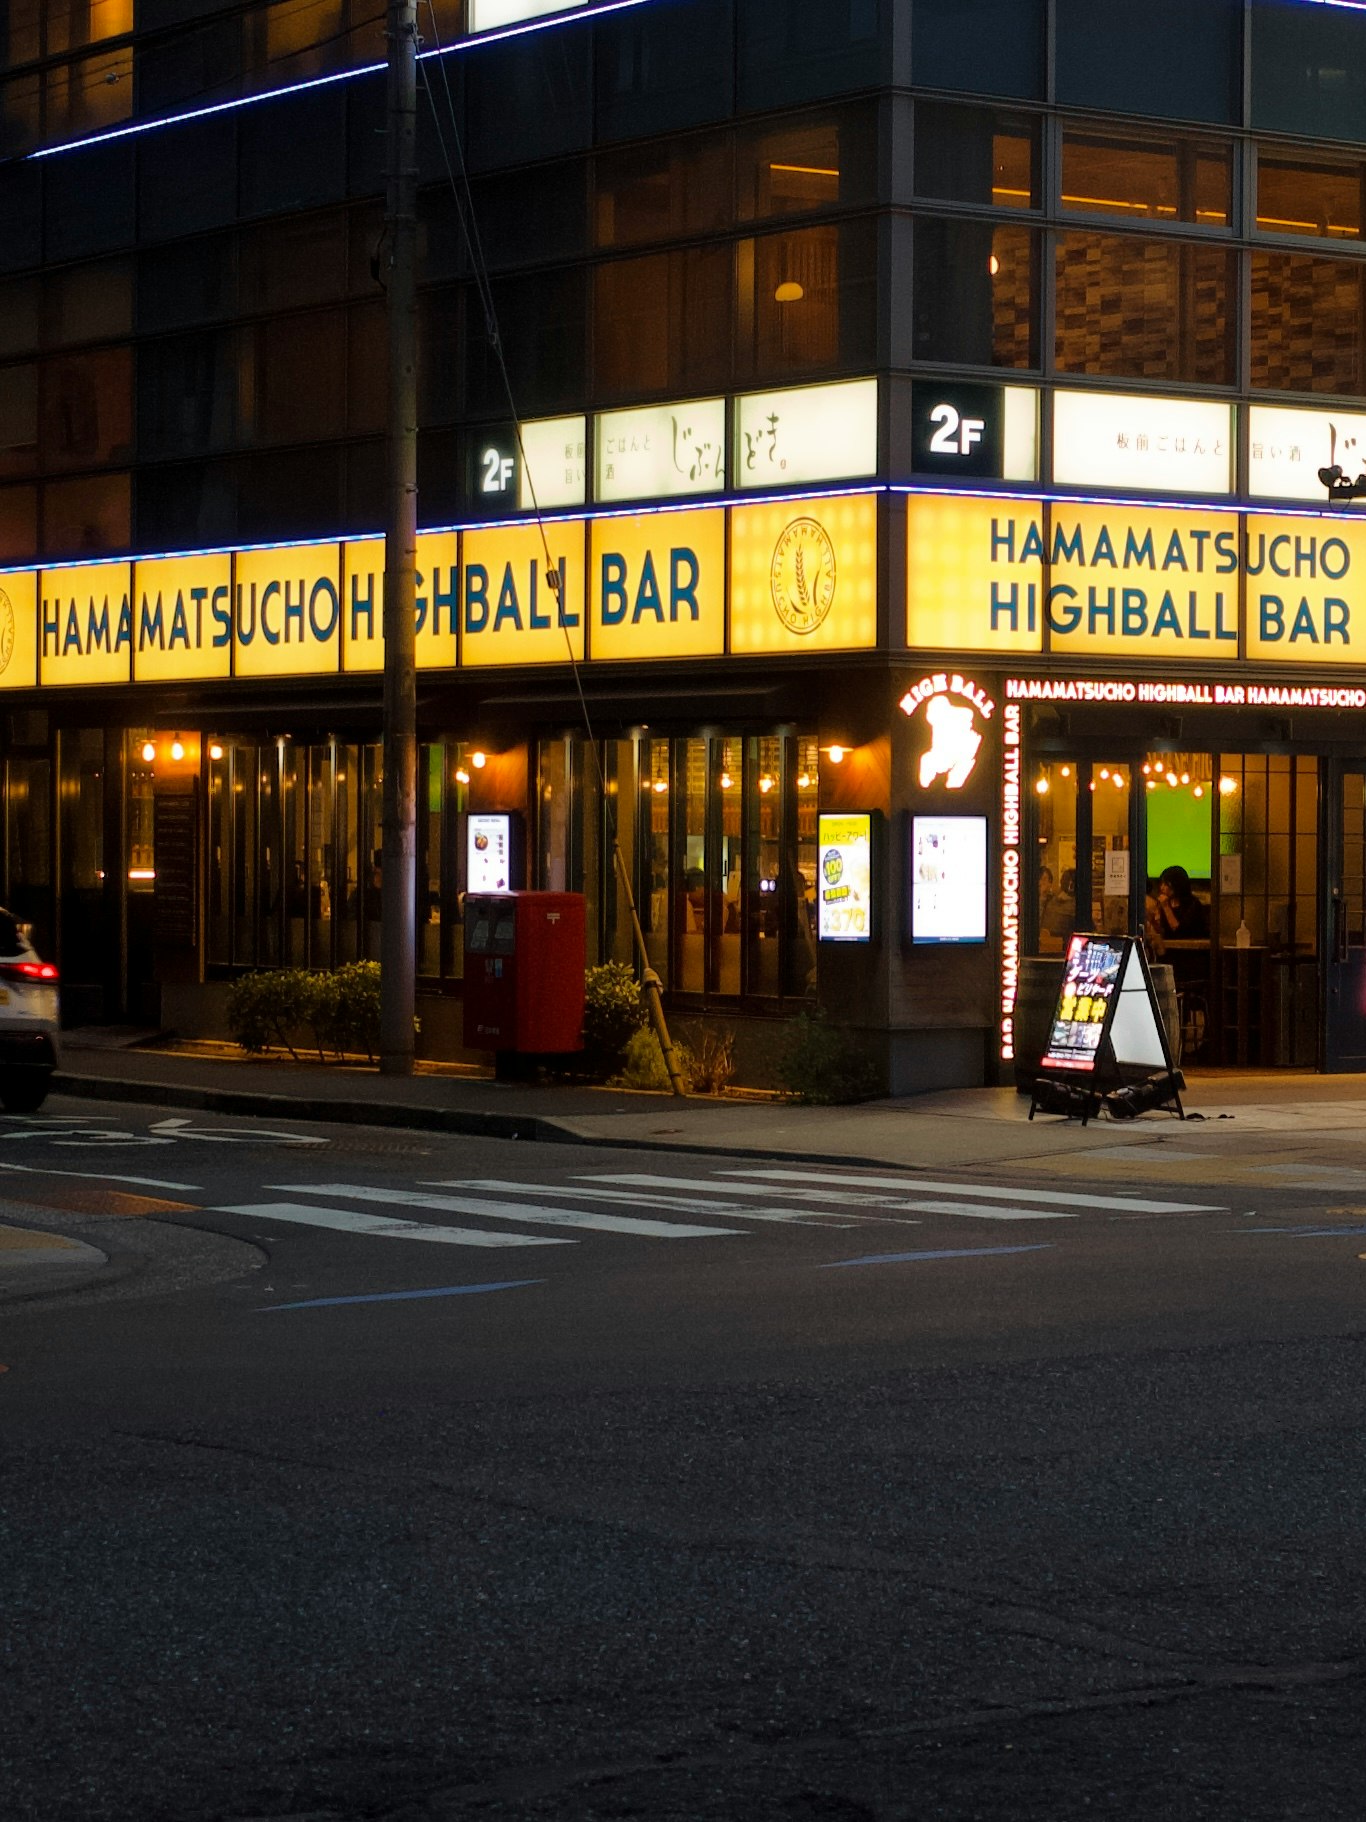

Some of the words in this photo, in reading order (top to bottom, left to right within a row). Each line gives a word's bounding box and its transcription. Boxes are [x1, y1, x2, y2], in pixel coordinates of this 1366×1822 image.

[928, 403, 986, 456] 2F
[482, 447, 514, 493] 2F
[990, 518, 1350, 580] HAMAMATSUCHO
[42, 576, 338, 657] HAMAMATSUCHO
[351, 556, 580, 640] HHBALL
[601, 547, 700, 626] BAR
[990, 581, 1238, 641] HIGHBALL
[1259, 594, 1350, 645] BAR
[949, 674, 997, 719] BALL
[1006, 680, 1135, 701] HAMAMATSUCHO
[1138, 683, 1213, 703] HIGHBALL
[1214, 685, 1245, 704] BAR
[1247, 686, 1366, 708] HAMAMATSUCHO
[1004, 704, 1020, 745] BAR
[1003, 747, 1020, 845] HIGHBALL
